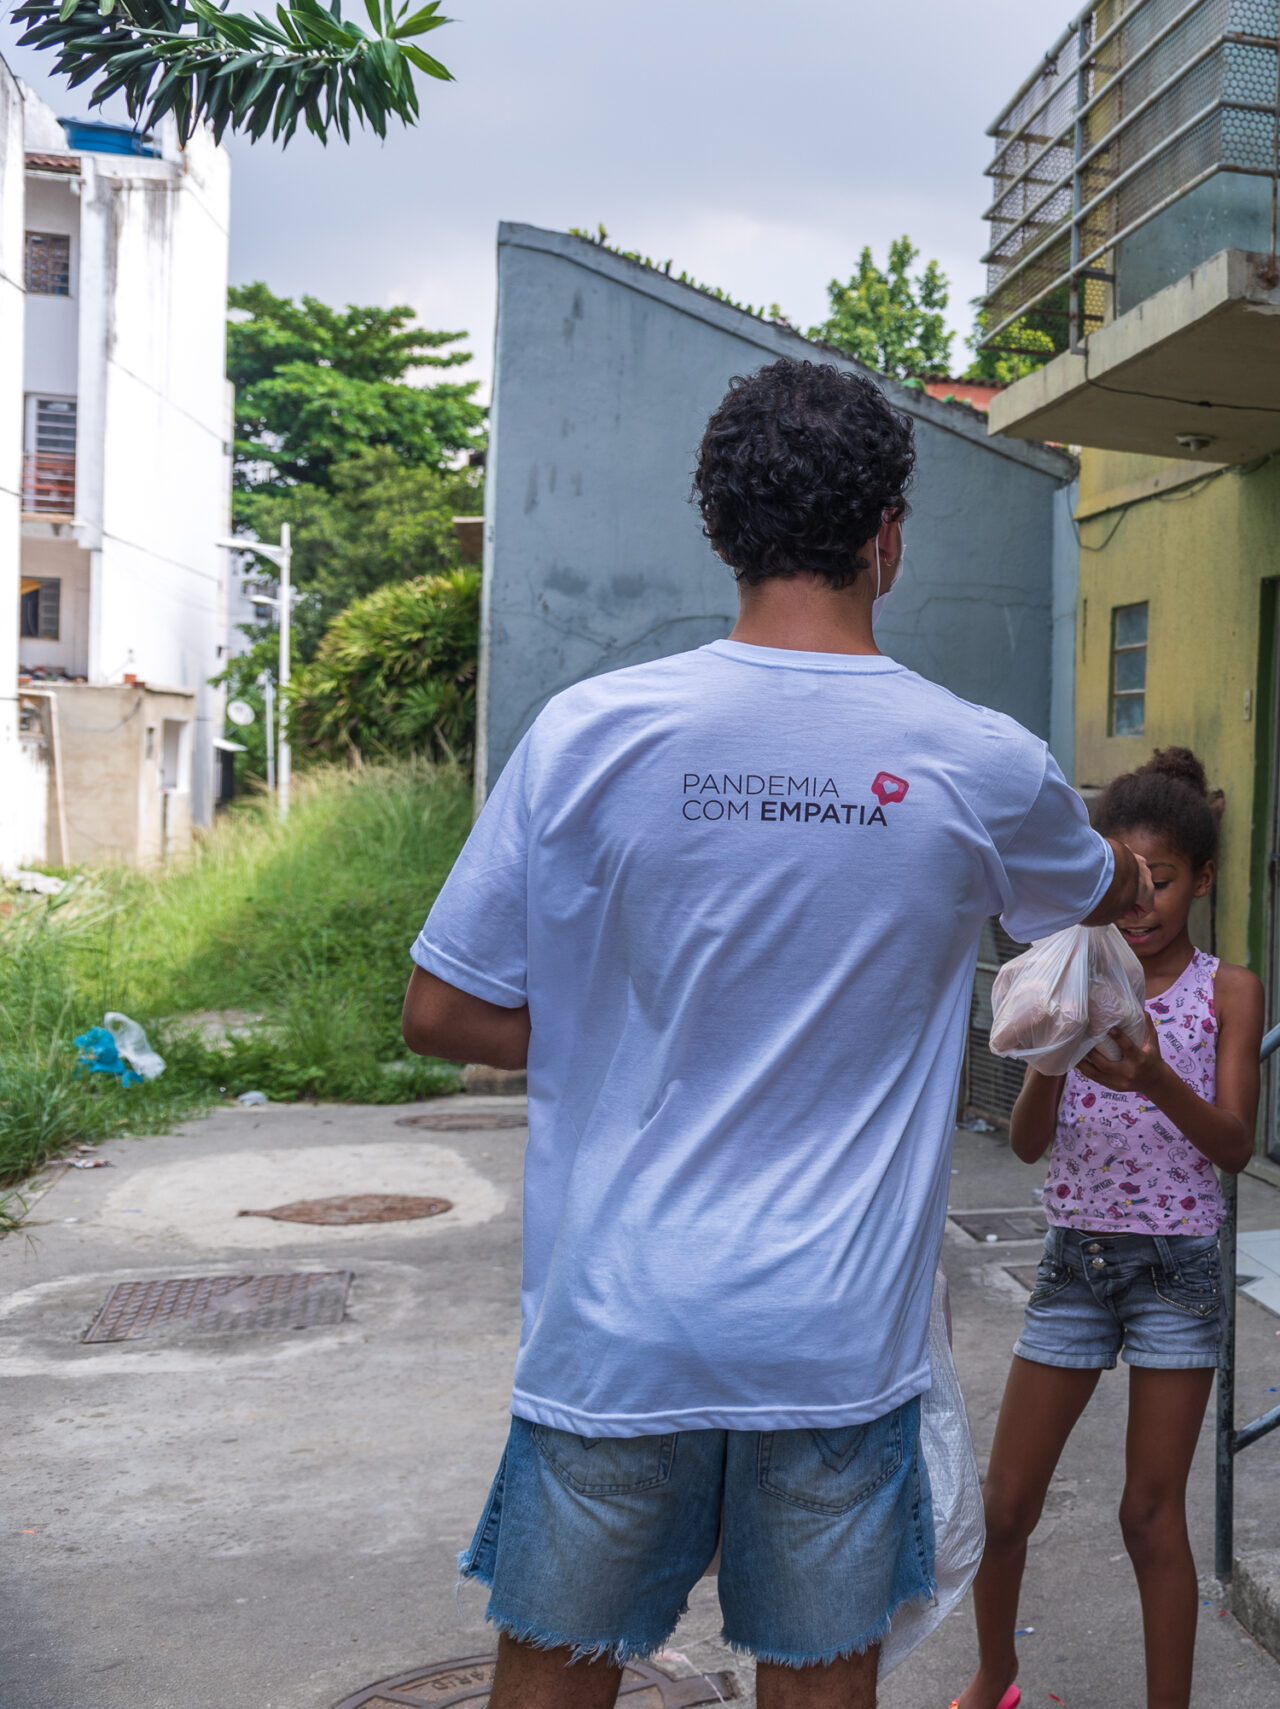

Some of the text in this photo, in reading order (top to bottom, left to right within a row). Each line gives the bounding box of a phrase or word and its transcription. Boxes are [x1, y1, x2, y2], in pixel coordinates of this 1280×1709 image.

[683, 773, 839, 798] PANDEMIA
[682, 800, 888, 826] COM EMPATIA
[1100, 1090, 1129, 1103] SUPERGIRL
